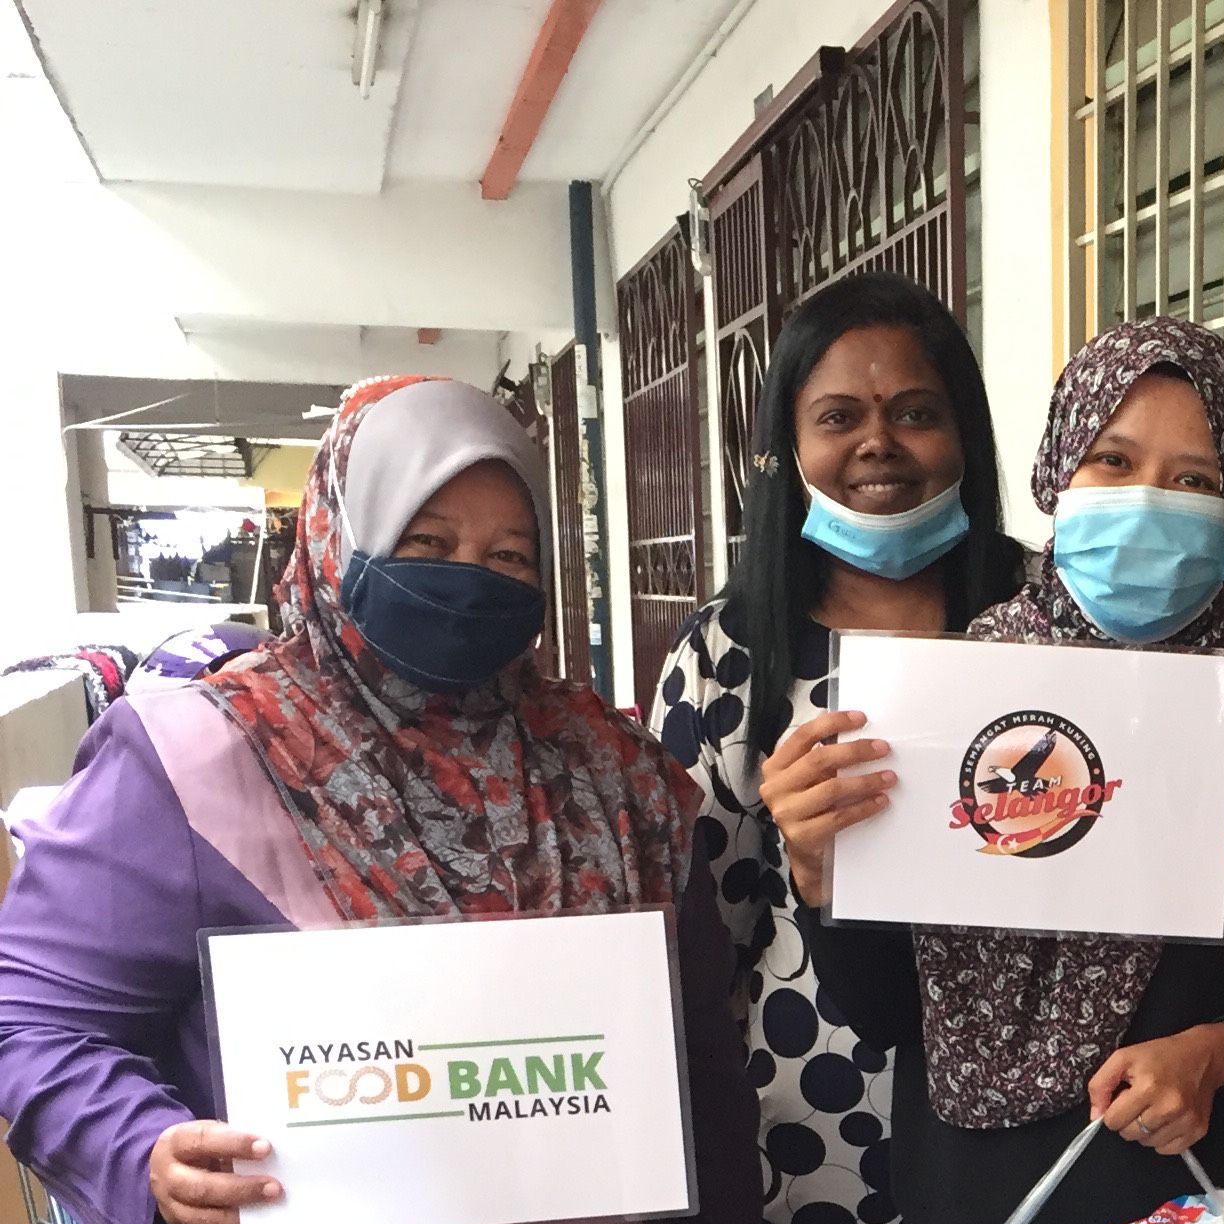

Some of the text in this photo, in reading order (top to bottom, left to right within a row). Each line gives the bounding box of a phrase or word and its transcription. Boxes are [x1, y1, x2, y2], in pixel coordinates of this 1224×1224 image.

[966, 714, 1096, 773] SEMANGAT MERAH KUNING
[949, 779, 1123, 829] Selangor
[1006, 775, 1063, 794] TEAM
[279, 1038, 414, 1065] YAYASAN
[286, 1052, 608, 1109] FOOD BANK
[468, 1094, 612, 1122] MALAYSIA
